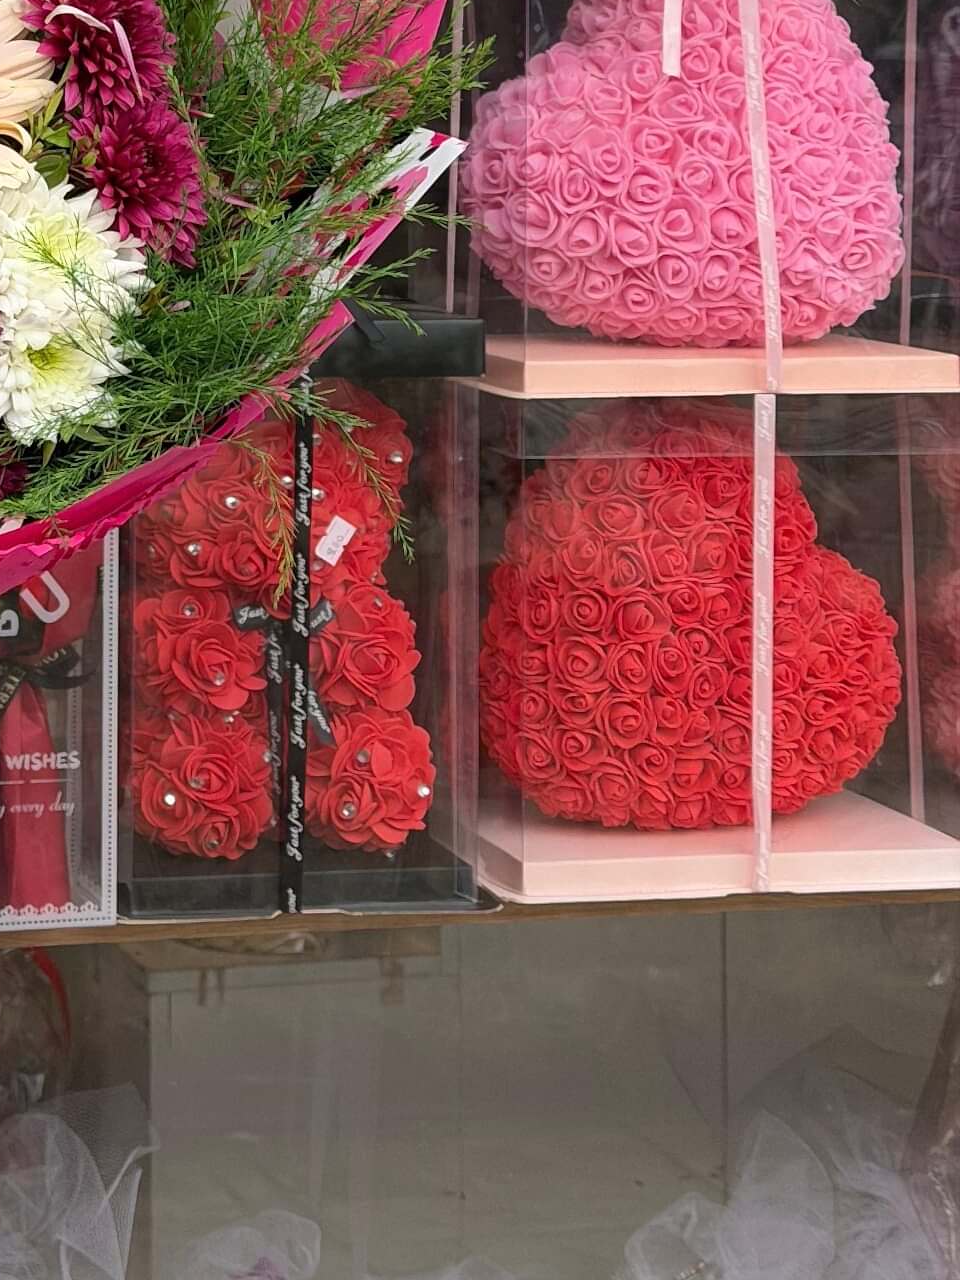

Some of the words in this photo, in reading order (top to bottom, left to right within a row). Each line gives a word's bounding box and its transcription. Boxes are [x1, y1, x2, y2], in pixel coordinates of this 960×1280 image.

[296, 469, 312, 497] for
[296, 493, 312, 527] Just
[19, 570, 71, 624] U
[293, 582, 310, 609] for
[292, 604, 309, 637] Just
[291, 691, 307, 721] for
[290, 715, 306, 750] Just
[5, 750, 81, 772] WISHES
[10, 802, 46, 818] every
[49, 790, 77, 817] day
[287, 803, 304, 833] for
[286, 826, 303, 862] Just
